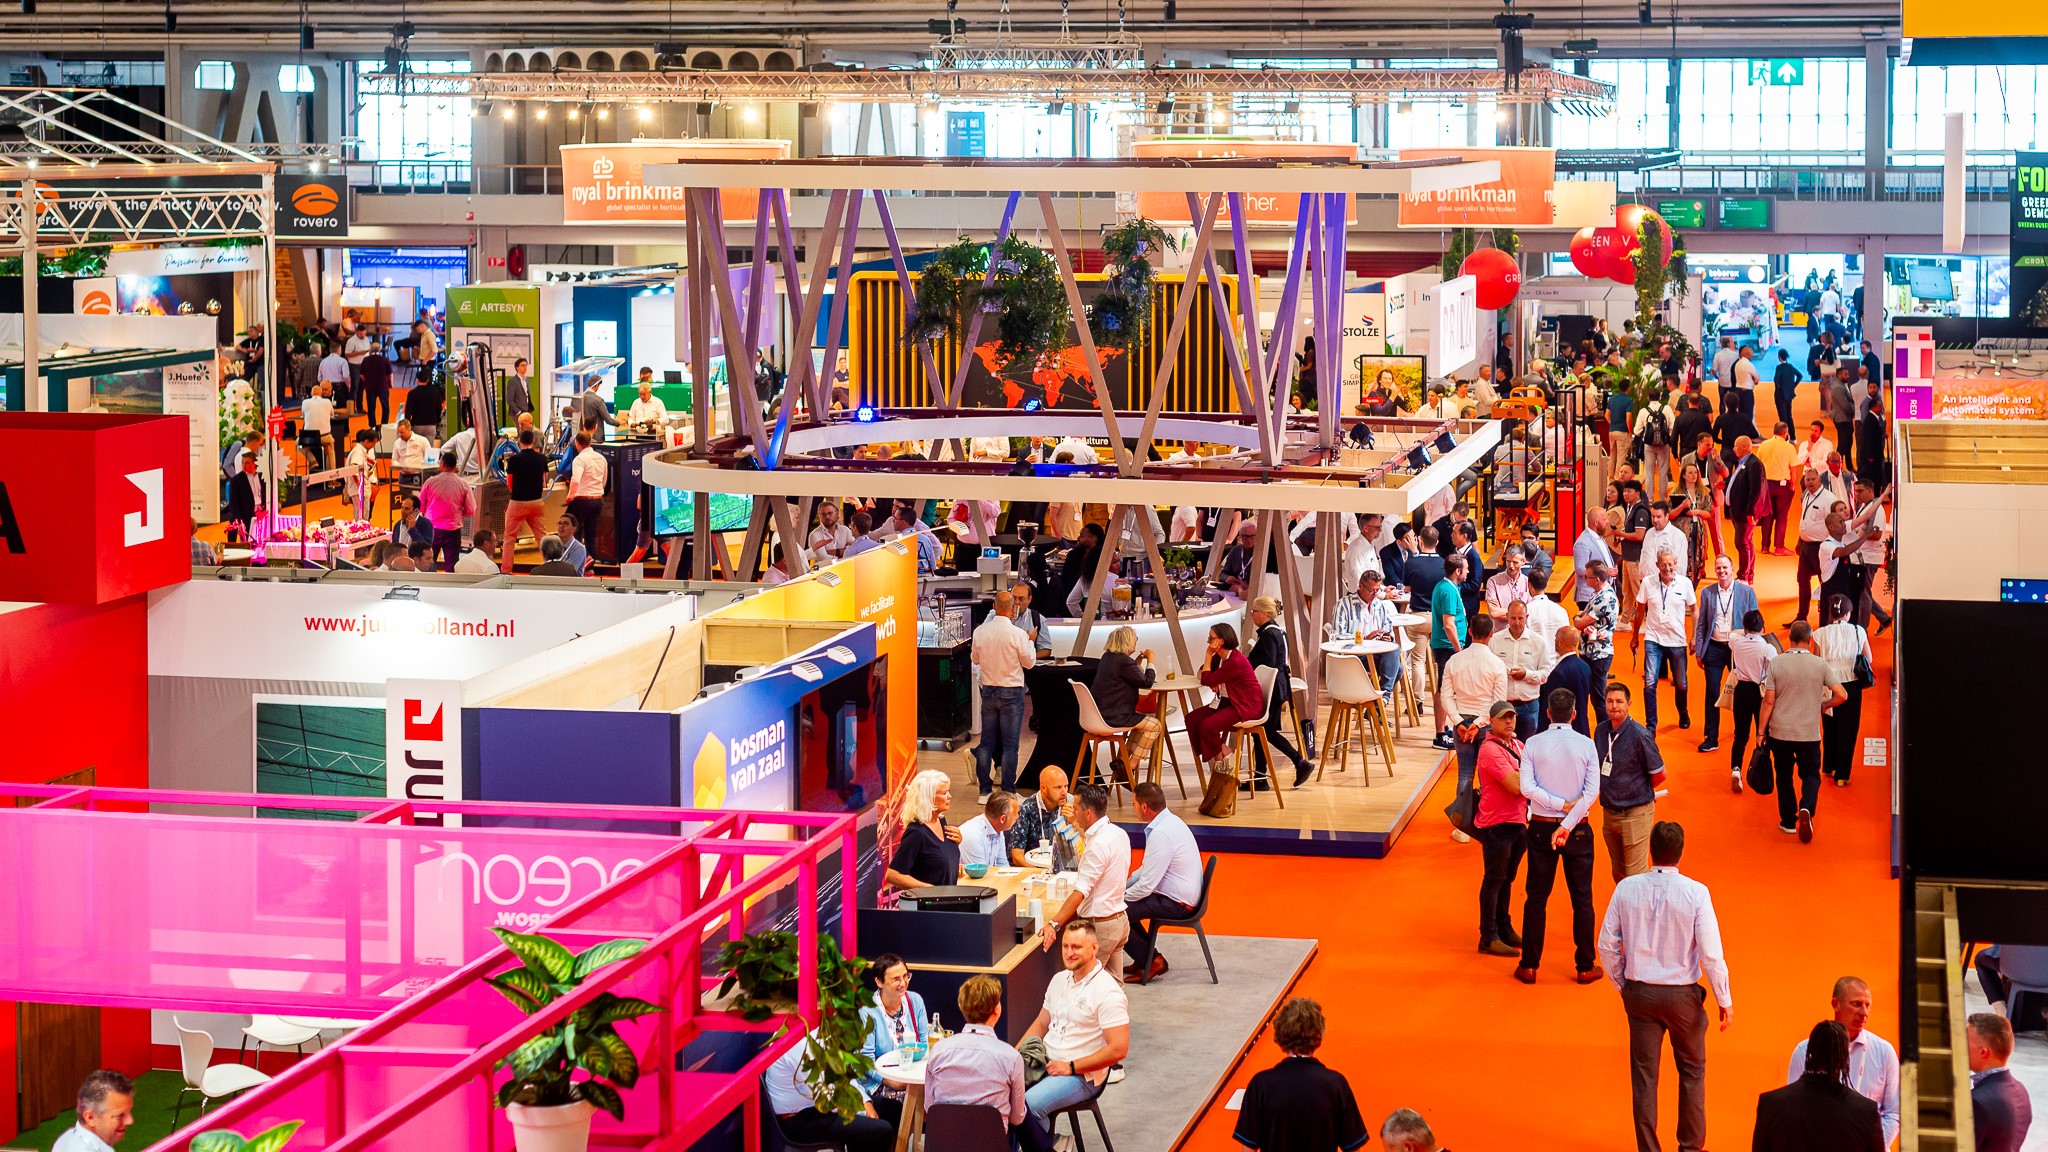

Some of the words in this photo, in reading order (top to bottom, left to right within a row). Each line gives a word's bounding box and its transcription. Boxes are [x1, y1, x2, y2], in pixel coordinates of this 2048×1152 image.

[572, 181, 601, 206] royal
[1437, 185, 1516, 203] brinkman
[125, 199, 148, 211] the
[227, 199, 241, 211] to
[607, 203, 623, 213] global
[624, 203, 651, 212] specialist
[653, 203, 659, 211] in
[1437, 205, 1453, 213] global
[1487, 205, 1517, 213] horticulture
[293, 216, 338, 228] rovero
[200, 253, 214, 270] for
[480, 303, 525, 313] ARTESYN
[1343, 327, 1380, 338] STOLZE
[168, 372, 202, 382] J.Huete
[1942, 395, 1957, 404] An
[1959, 394, 2010, 406] intelligent
[2012, 395, 2032, 404] and
[1942, 406, 1997, 415] automated
[1999, 407, 2035, 416] system
[860, 605, 870, 619] we
[870, 595, 895, 615] facilitate
[731, 719, 786, 767] bosman
[731, 762, 757, 794] van
[757, 742, 786, 781] zaal
